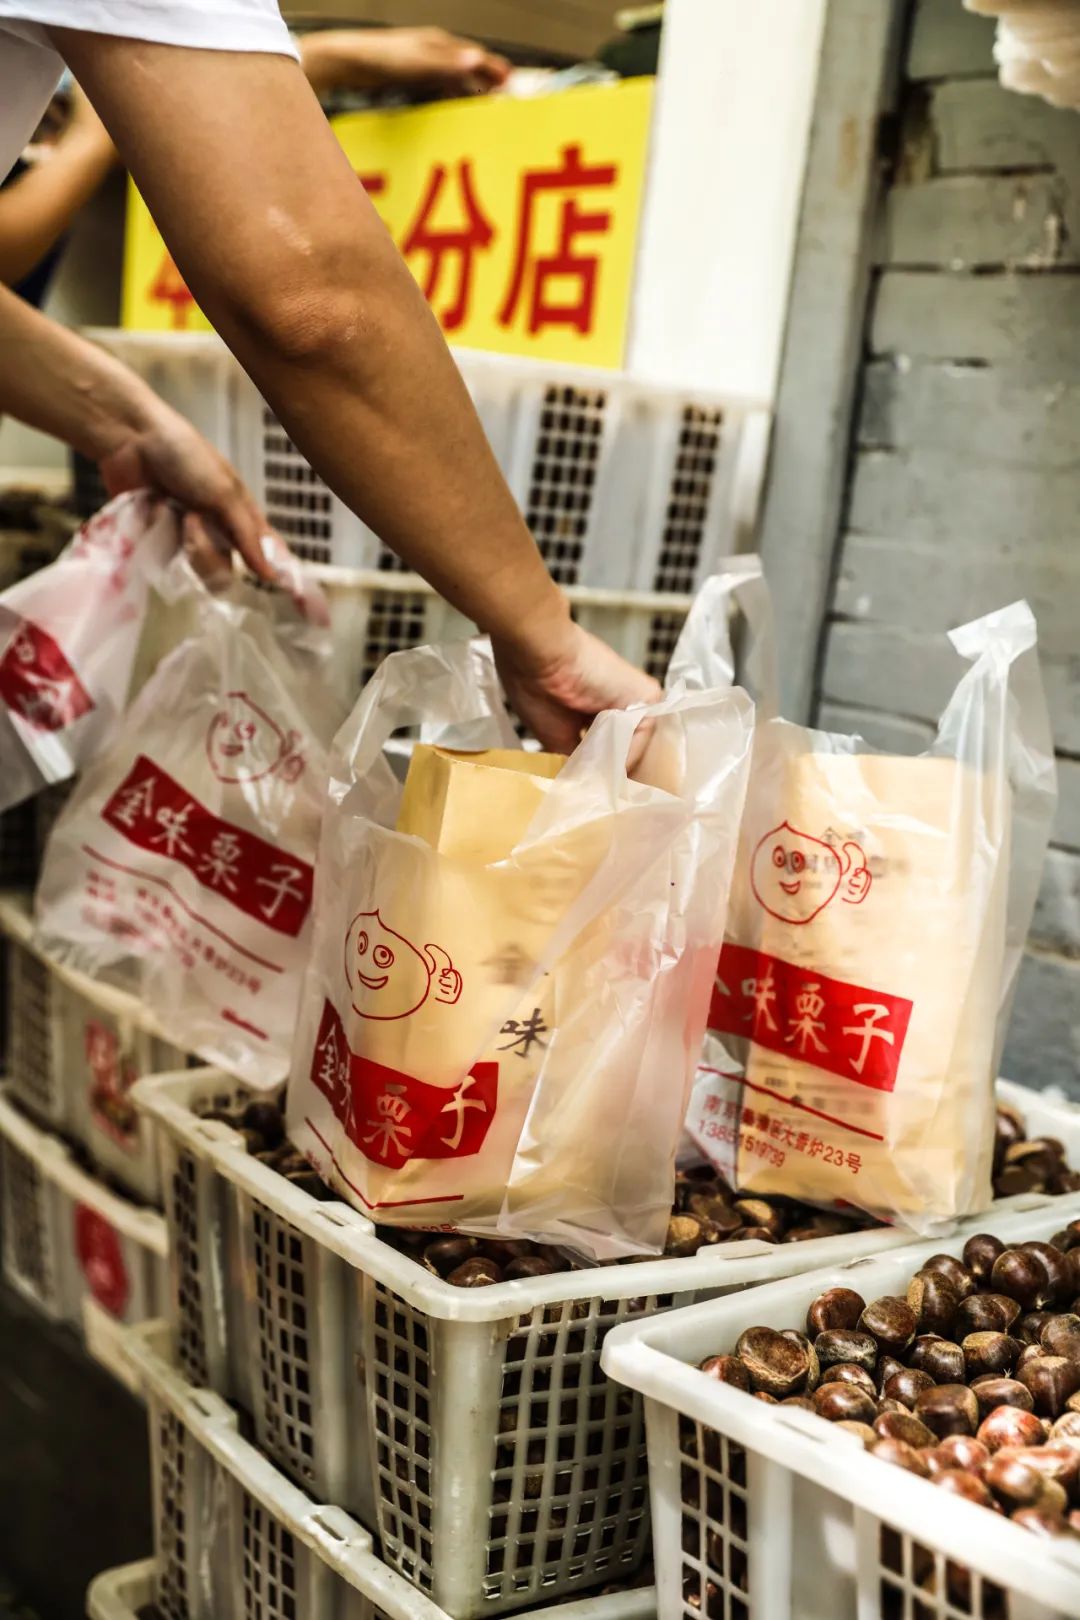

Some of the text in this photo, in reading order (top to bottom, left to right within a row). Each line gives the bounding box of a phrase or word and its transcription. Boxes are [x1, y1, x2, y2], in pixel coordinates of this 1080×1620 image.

[362, 143, 618, 336] 分店
[716, 962, 895, 1075] 味栗子
